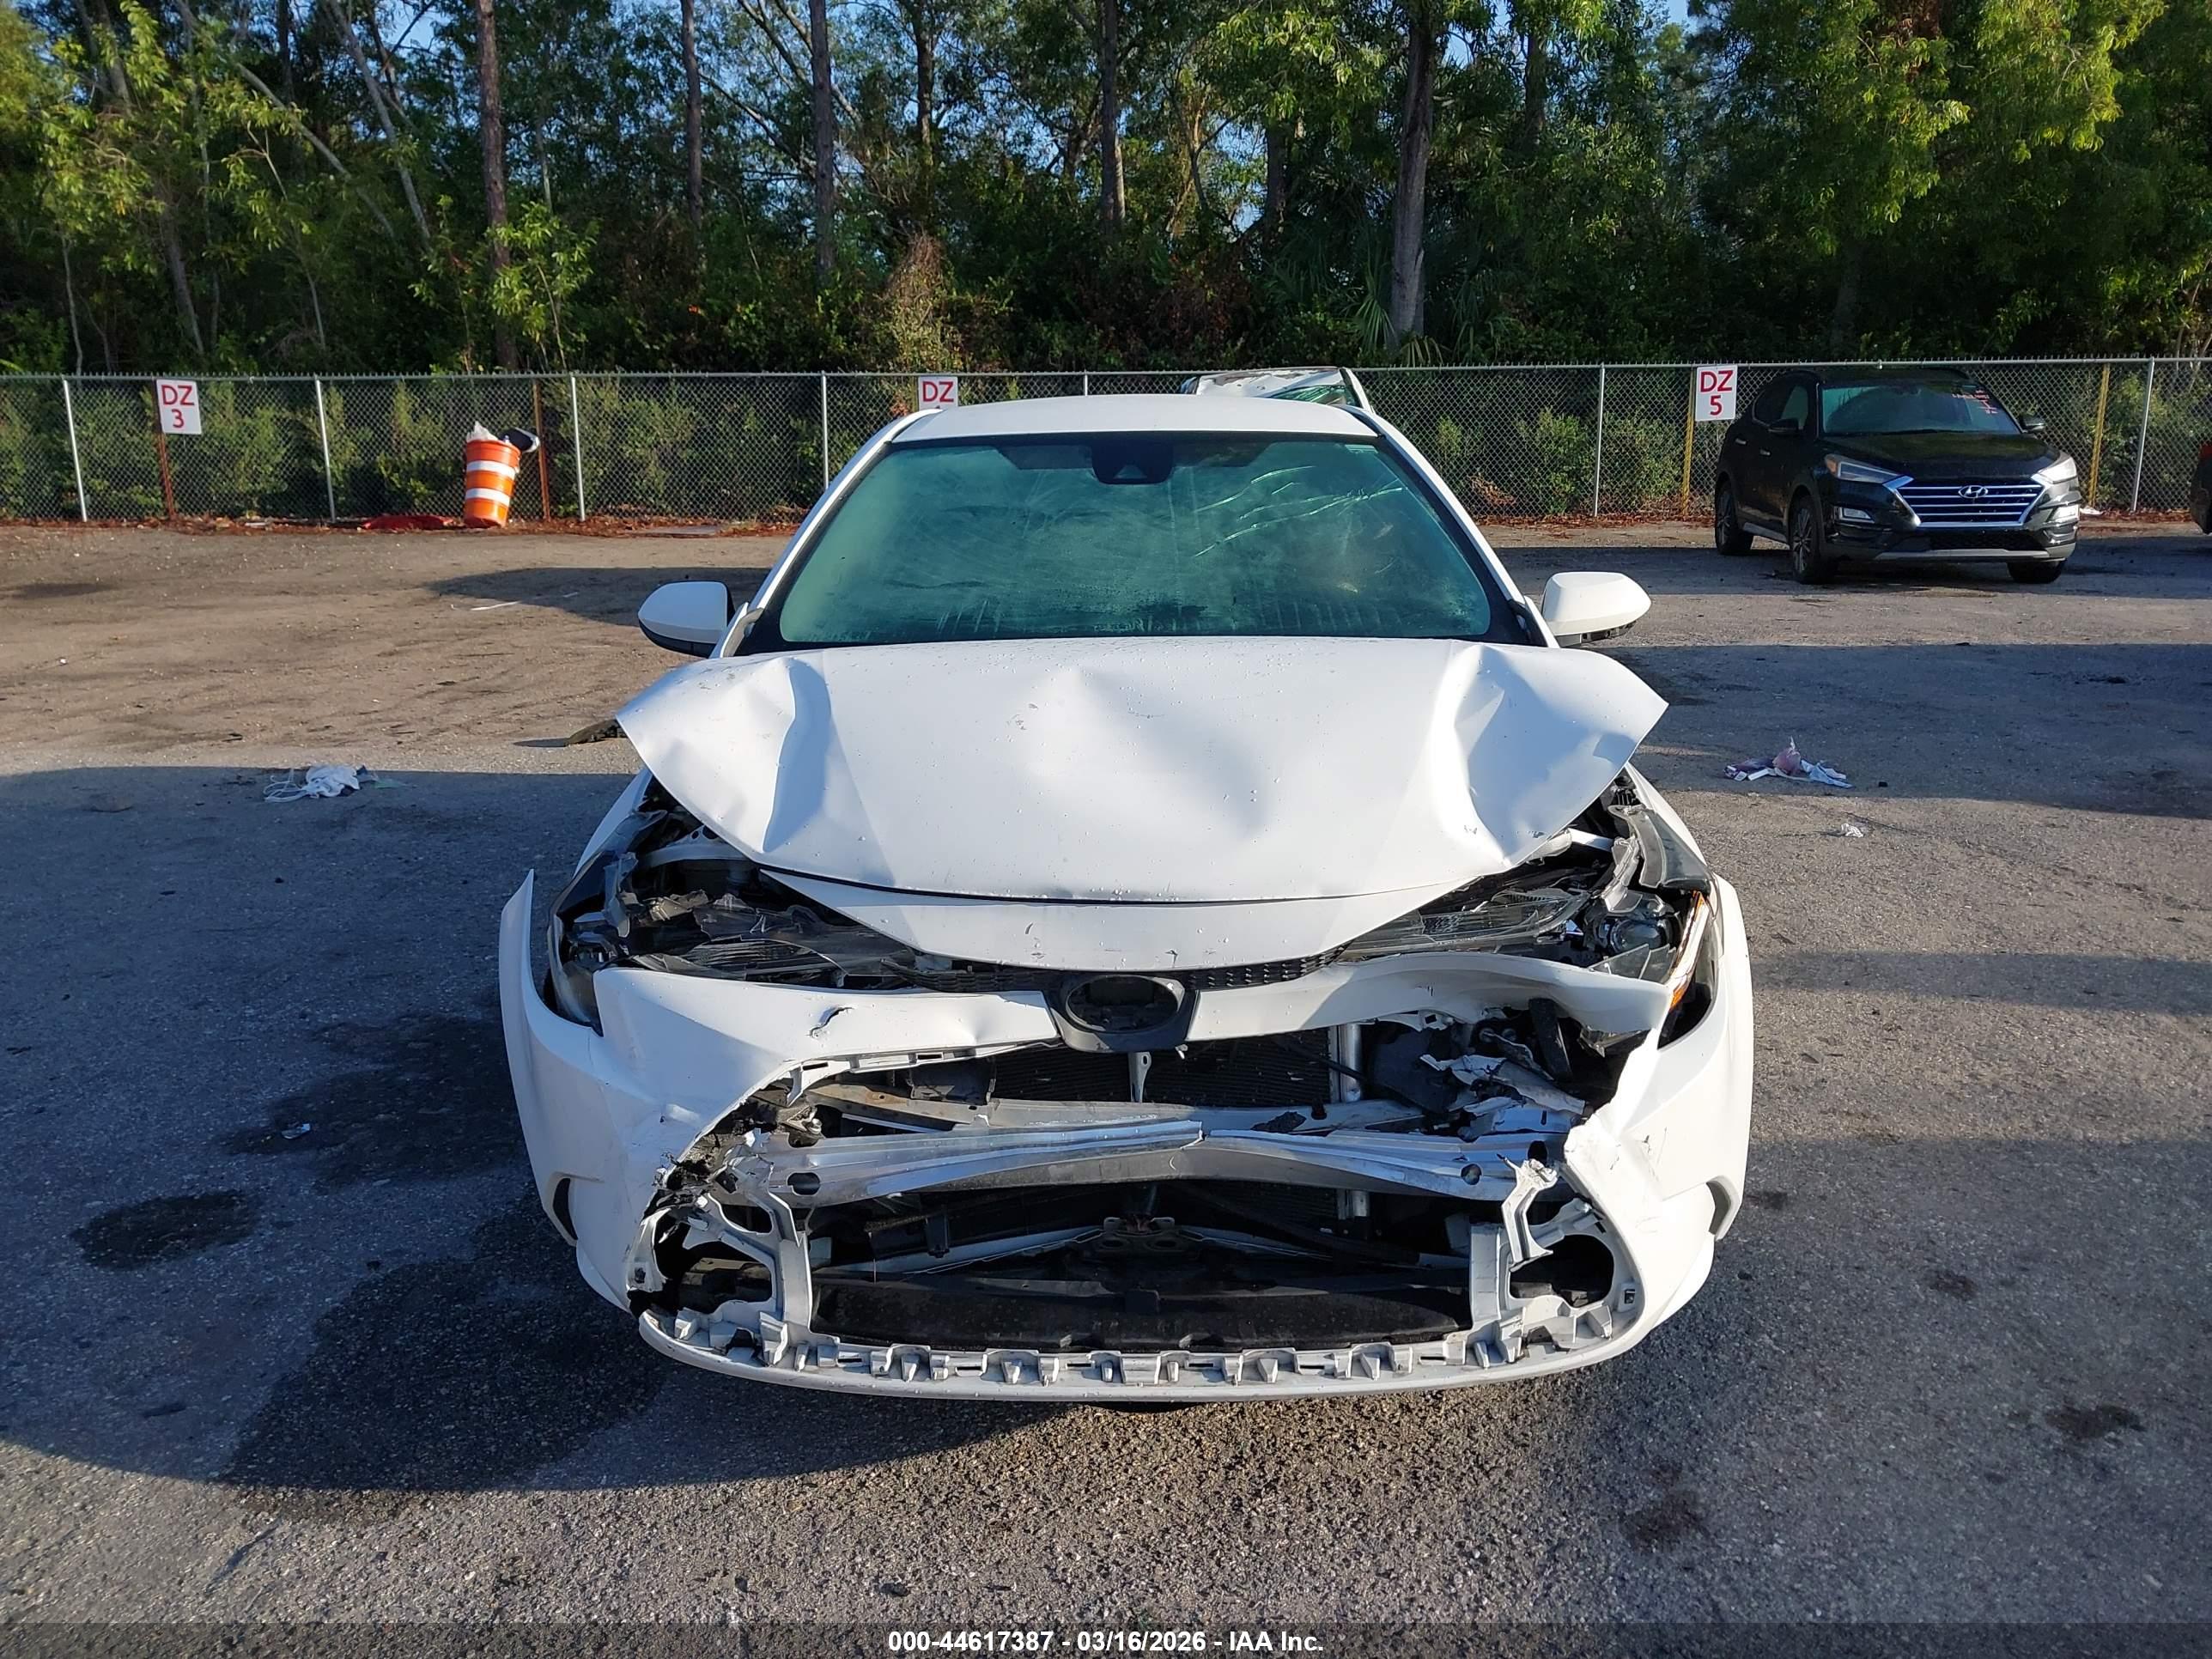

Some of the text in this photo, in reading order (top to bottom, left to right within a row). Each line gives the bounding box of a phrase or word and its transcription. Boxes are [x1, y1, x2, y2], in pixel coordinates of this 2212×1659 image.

[922, 380, 954, 403] DZ
[1700, 370, 1734, 392] DZ
[161, 385, 195, 406] DZ
[1710, 395, 1723, 416] 5
[171, 409, 185, 428] 3
